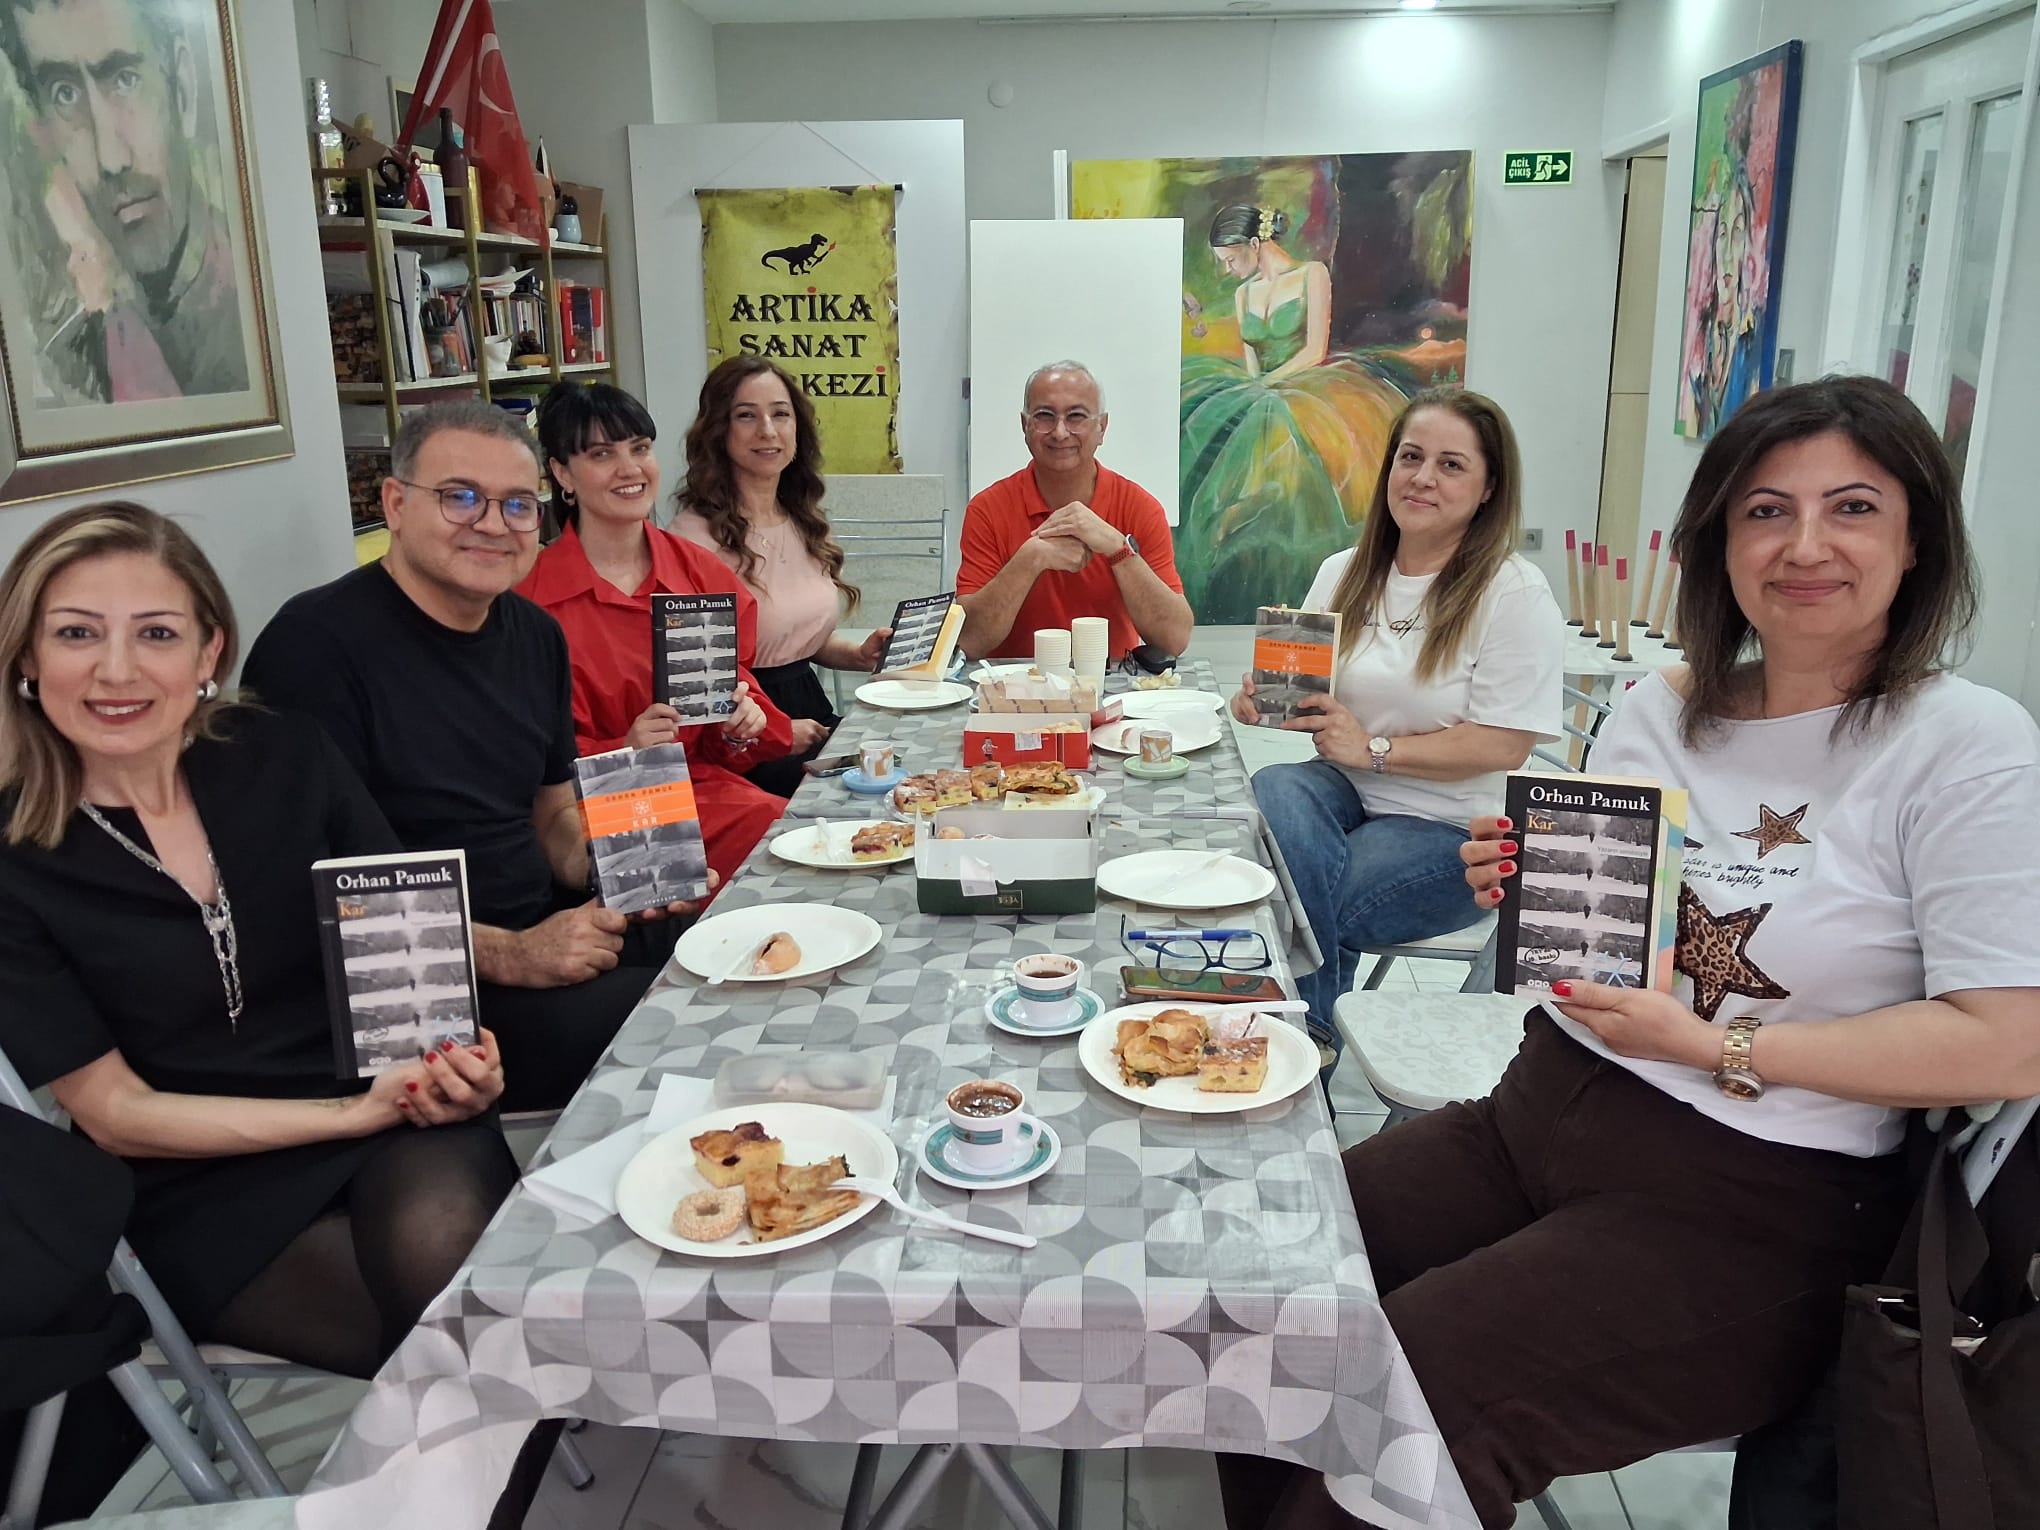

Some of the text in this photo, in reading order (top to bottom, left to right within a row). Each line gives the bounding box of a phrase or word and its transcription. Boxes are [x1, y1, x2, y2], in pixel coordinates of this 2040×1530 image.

[1511, 157, 1530, 168] ACİL
[1508, 168, 1531, 179] ÇIKIŞ
[739, 333, 867, 358] SANAT
[665, 599, 733, 610] Orhan Pamuk
[1529, 786, 1651, 811] Orhan Pamuk
[1527, 815, 1553, 830] Kar
[336, 867, 453, 889] Orhan Pamuk
[1727, 864, 1765, 877] unique
[1769, 867, 1800, 878] and
[1717, 872, 1765, 889] brightly
[340, 903, 367, 917] Kar
